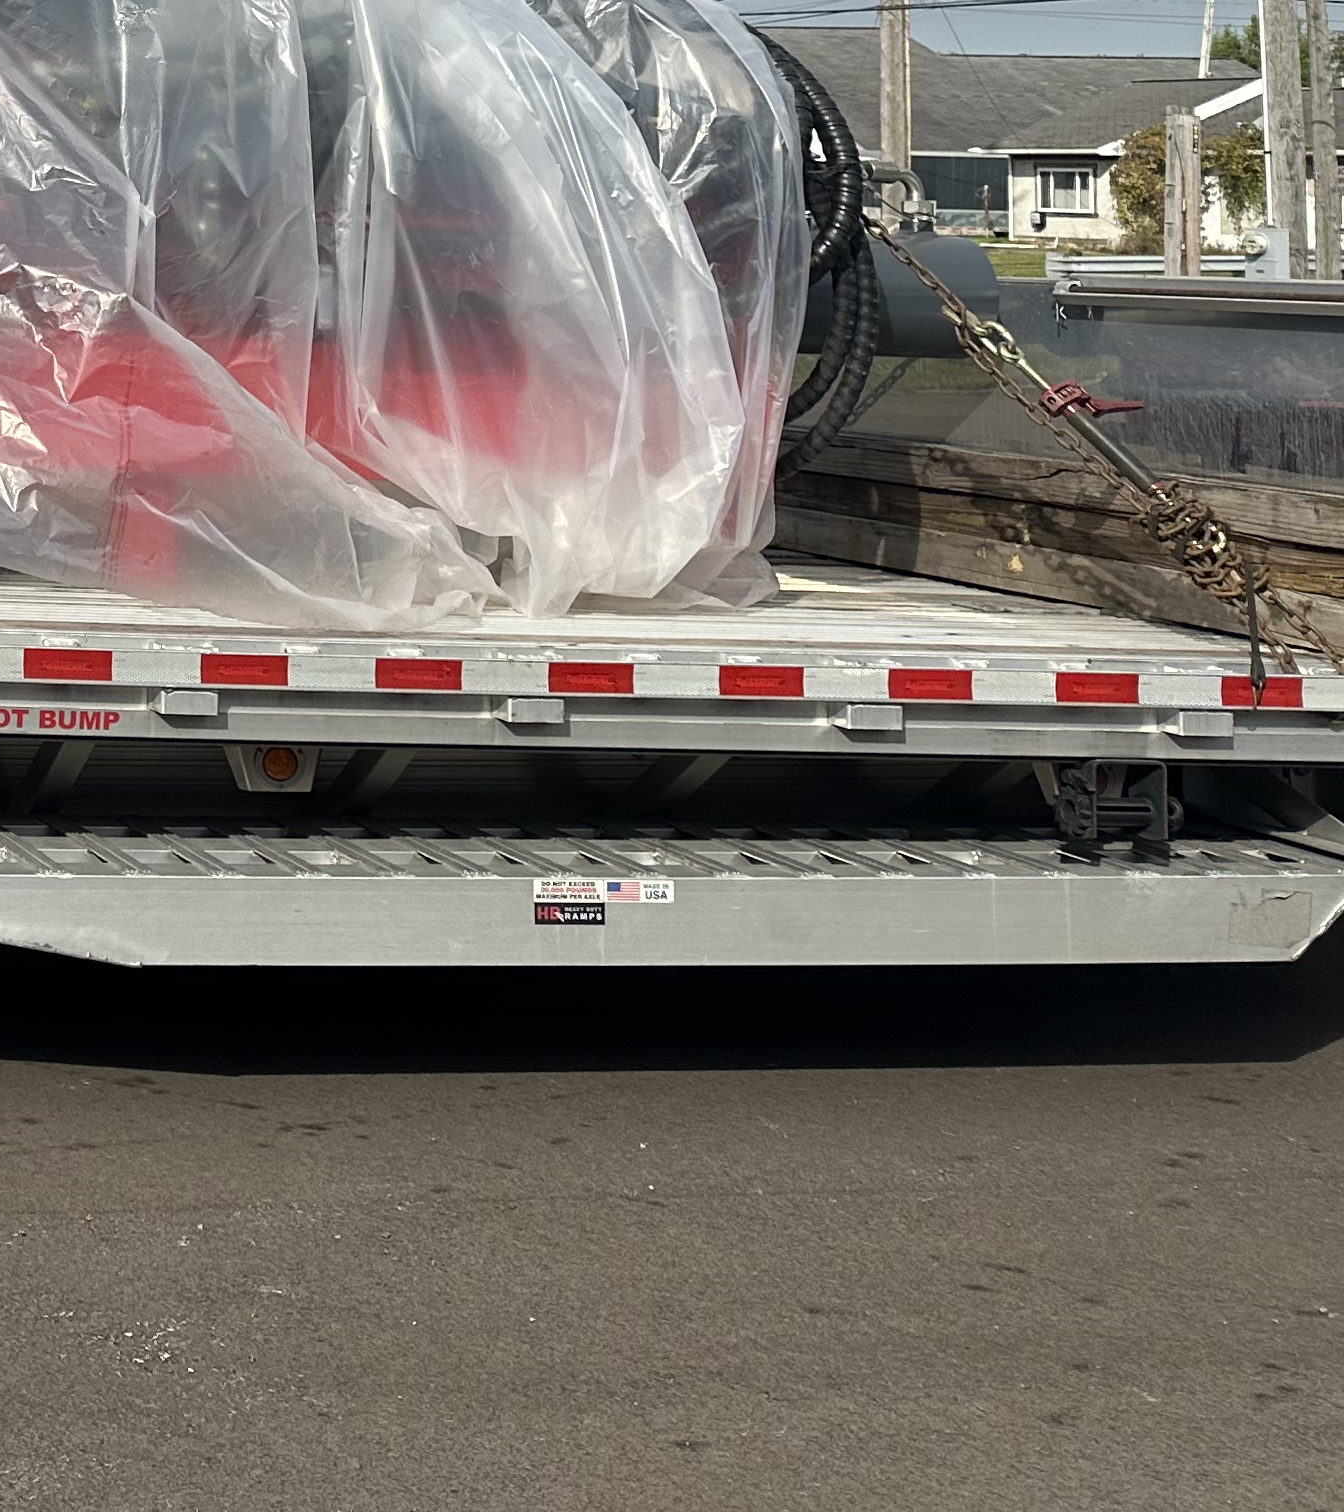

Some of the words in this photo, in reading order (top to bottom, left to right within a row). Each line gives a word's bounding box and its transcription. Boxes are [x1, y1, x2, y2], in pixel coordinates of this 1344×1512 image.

[39, 710, 120, 730] BUMP
[645, 890, 668, 900] USA
[563, 912, 603, 921] RAMPS
